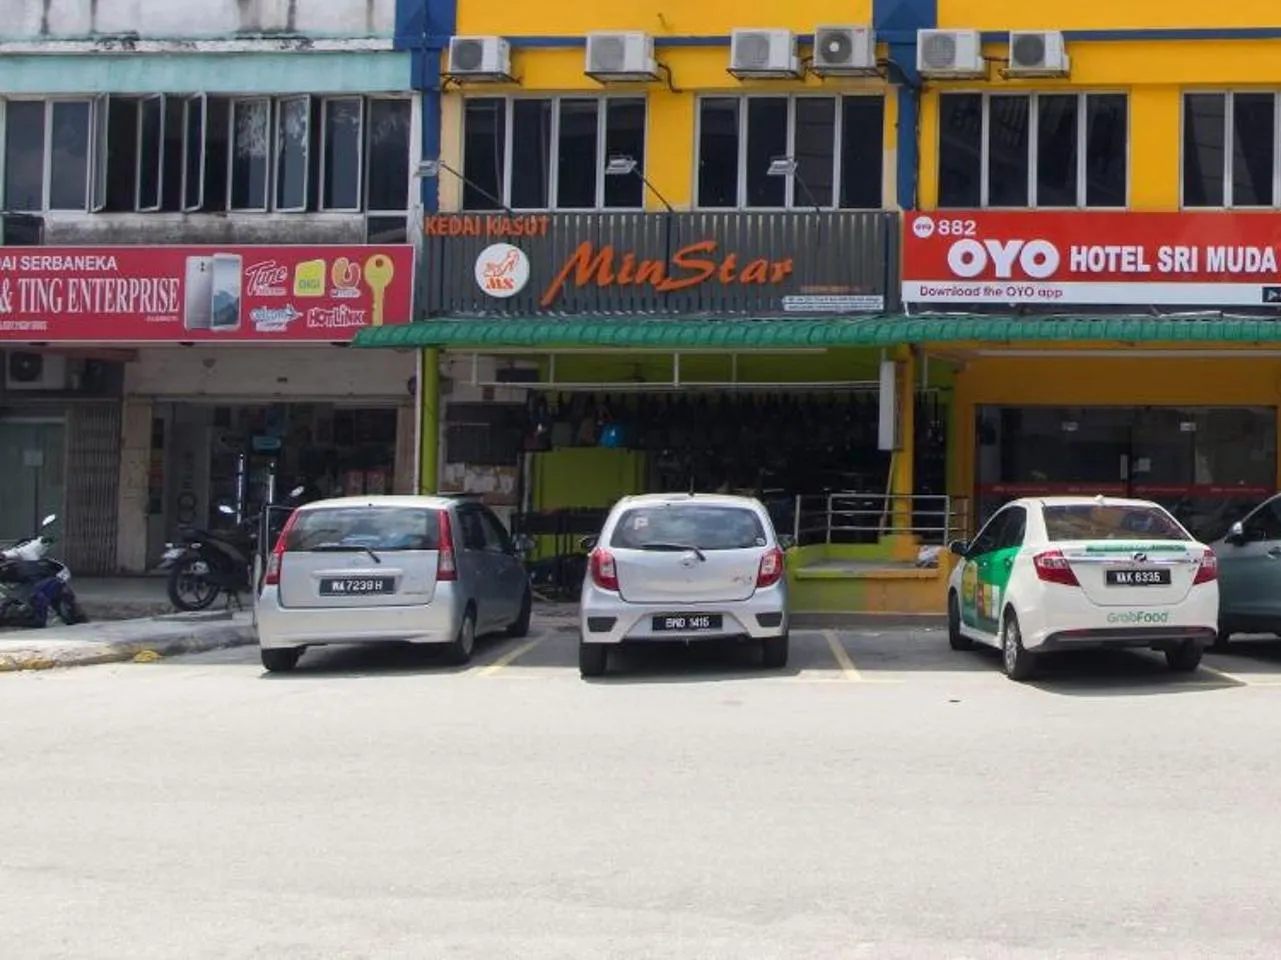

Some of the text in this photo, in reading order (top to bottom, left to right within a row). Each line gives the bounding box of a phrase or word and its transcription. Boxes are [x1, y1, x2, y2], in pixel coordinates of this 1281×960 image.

[425, 215, 550, 237] KEDAI KASUT
[938, 220, 976, 235] 882
[0, 256, 118, 271] AI SERBANEKA
[947, 238, 1060, 278] OYO
[1070, 246, 1150, 273] HOTEL
[1158, 246, 1197, 273] SRI
[1206, 246, 1278, 273] MUDA
[541, 241, 793, 307] MinStar
[0, 278, 180, 313] & TING ENTERPRISE
[920, 286, 1063, 299] Download the OYO app
[375, 580, 383, 591] H
[1107, 611, 1169, 623] GrabFood
